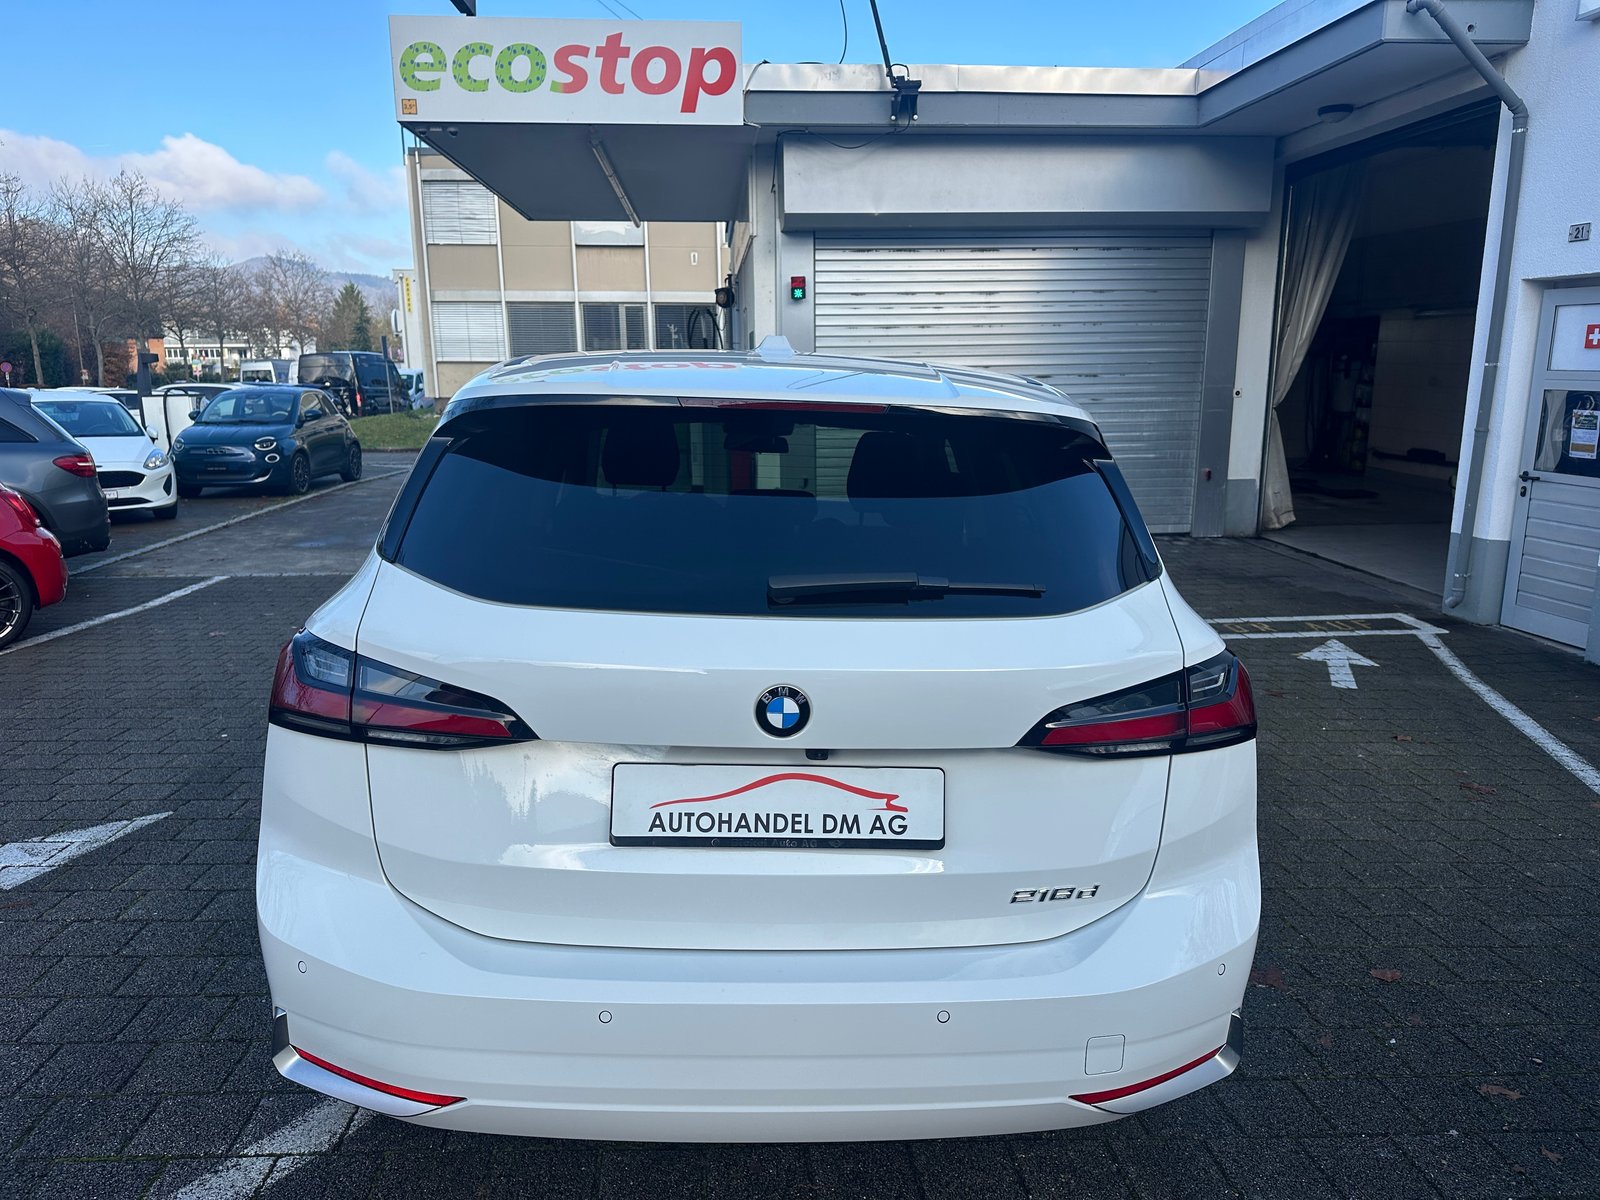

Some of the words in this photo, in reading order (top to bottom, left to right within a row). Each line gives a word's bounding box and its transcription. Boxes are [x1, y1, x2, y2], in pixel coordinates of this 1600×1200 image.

[399, 32, 737, 113] ecostop
[1574, 225, 1585, 239] 21
[761, 686, 807, 705] BMW
[648, 811, 813, 834] AUTOHANDEL
[822, 813, 861, 835] DM
[868, 814, 908, 836] AG
[1010, 883, 1100, 904] 218d
